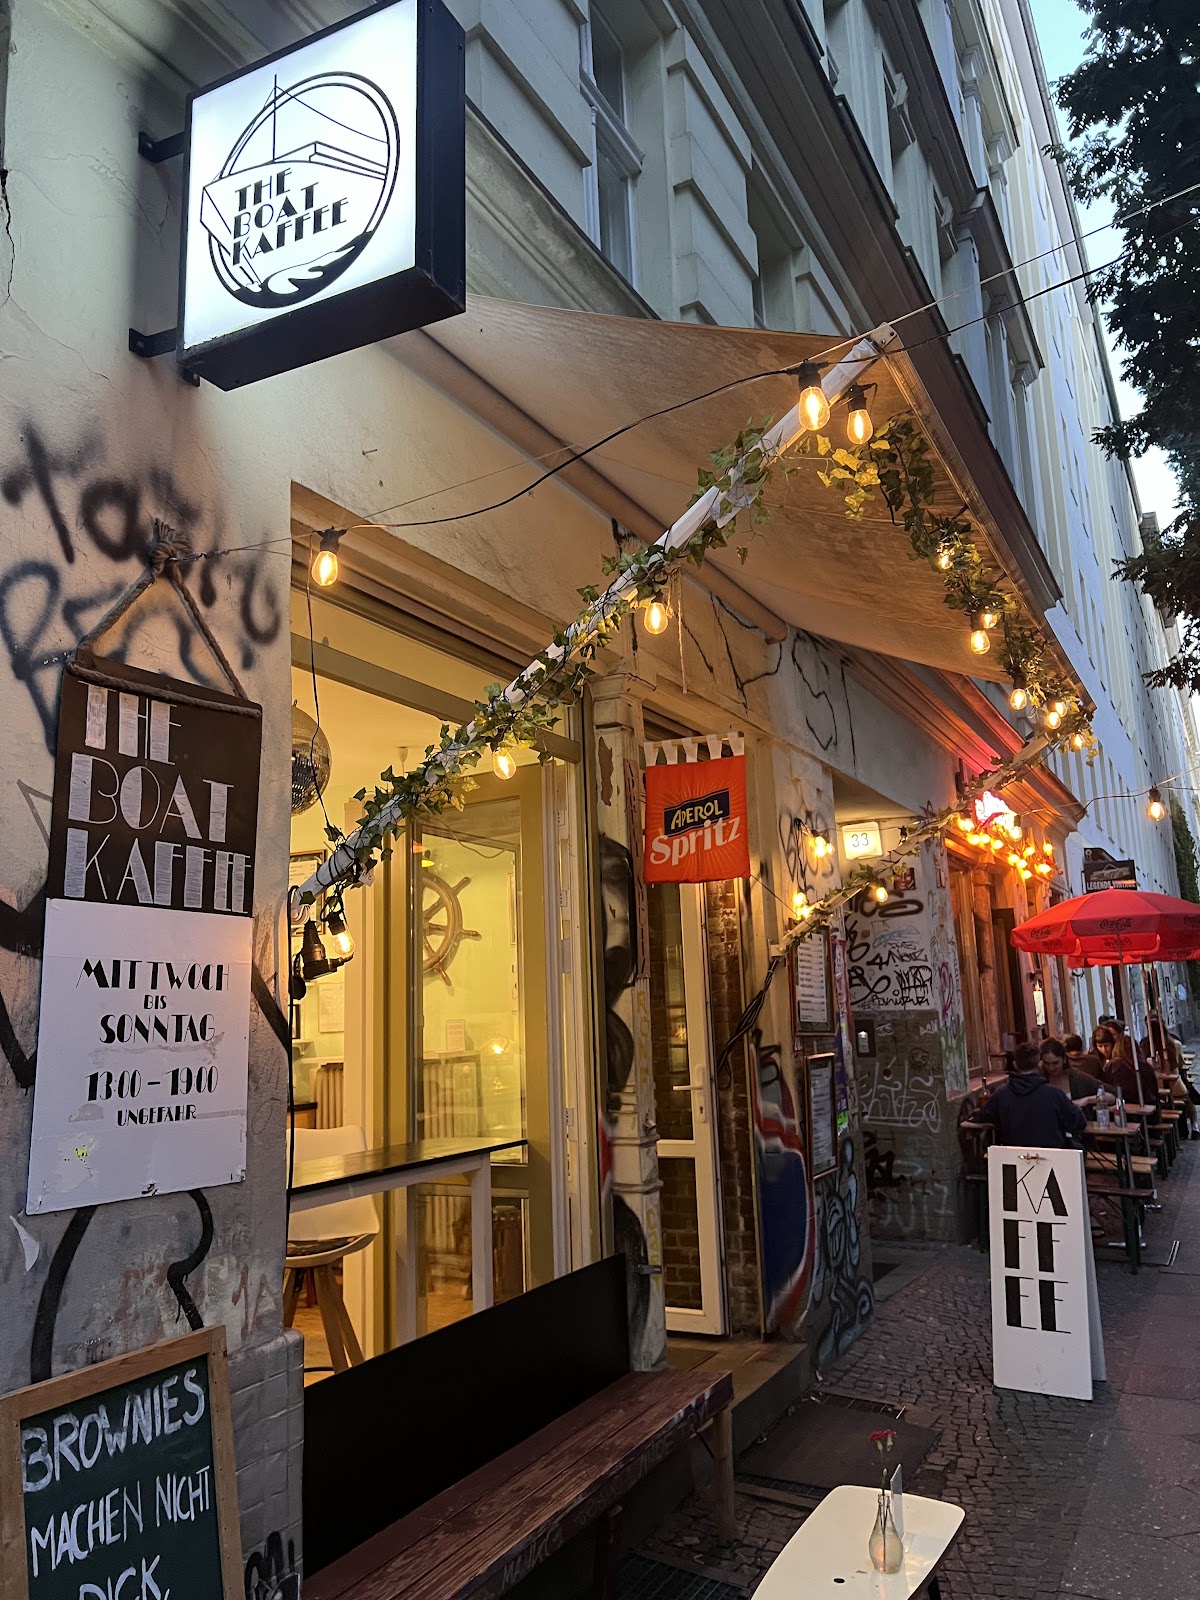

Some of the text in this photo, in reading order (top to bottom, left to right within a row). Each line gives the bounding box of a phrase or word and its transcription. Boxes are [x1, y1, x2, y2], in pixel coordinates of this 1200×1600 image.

[233, 182, 319, 240] BOAT
[235, 167, 292, 212] THE
[232, 197, 349, 266] KAFFEE
[78, 680, 182, 766] THE
[68, 752, 235, 843] BOAT
[670, 799, 724, 831] APEROL
[649, 815, 741, 867] Spritz
[851, 832, 870, 848] 33
[64, 827, 252, 914] KAFFEE
[1086, 880, 1112, 891] LEGENDS
[76, 958, 229, 992] MITTWOCH
[143, 994, 167, 1010] BIS
[99, 1013, 216, 1044] SONNTAG
[85, 1069, 142, 1101] 13:00
[165, 1065, 219, 1096] 19:00
[21, 1368, 206, 1493] BROWNIES
[30, 1480, 144, 1578] MACHEN
[155, 1465, 210, 1528] NICHT
